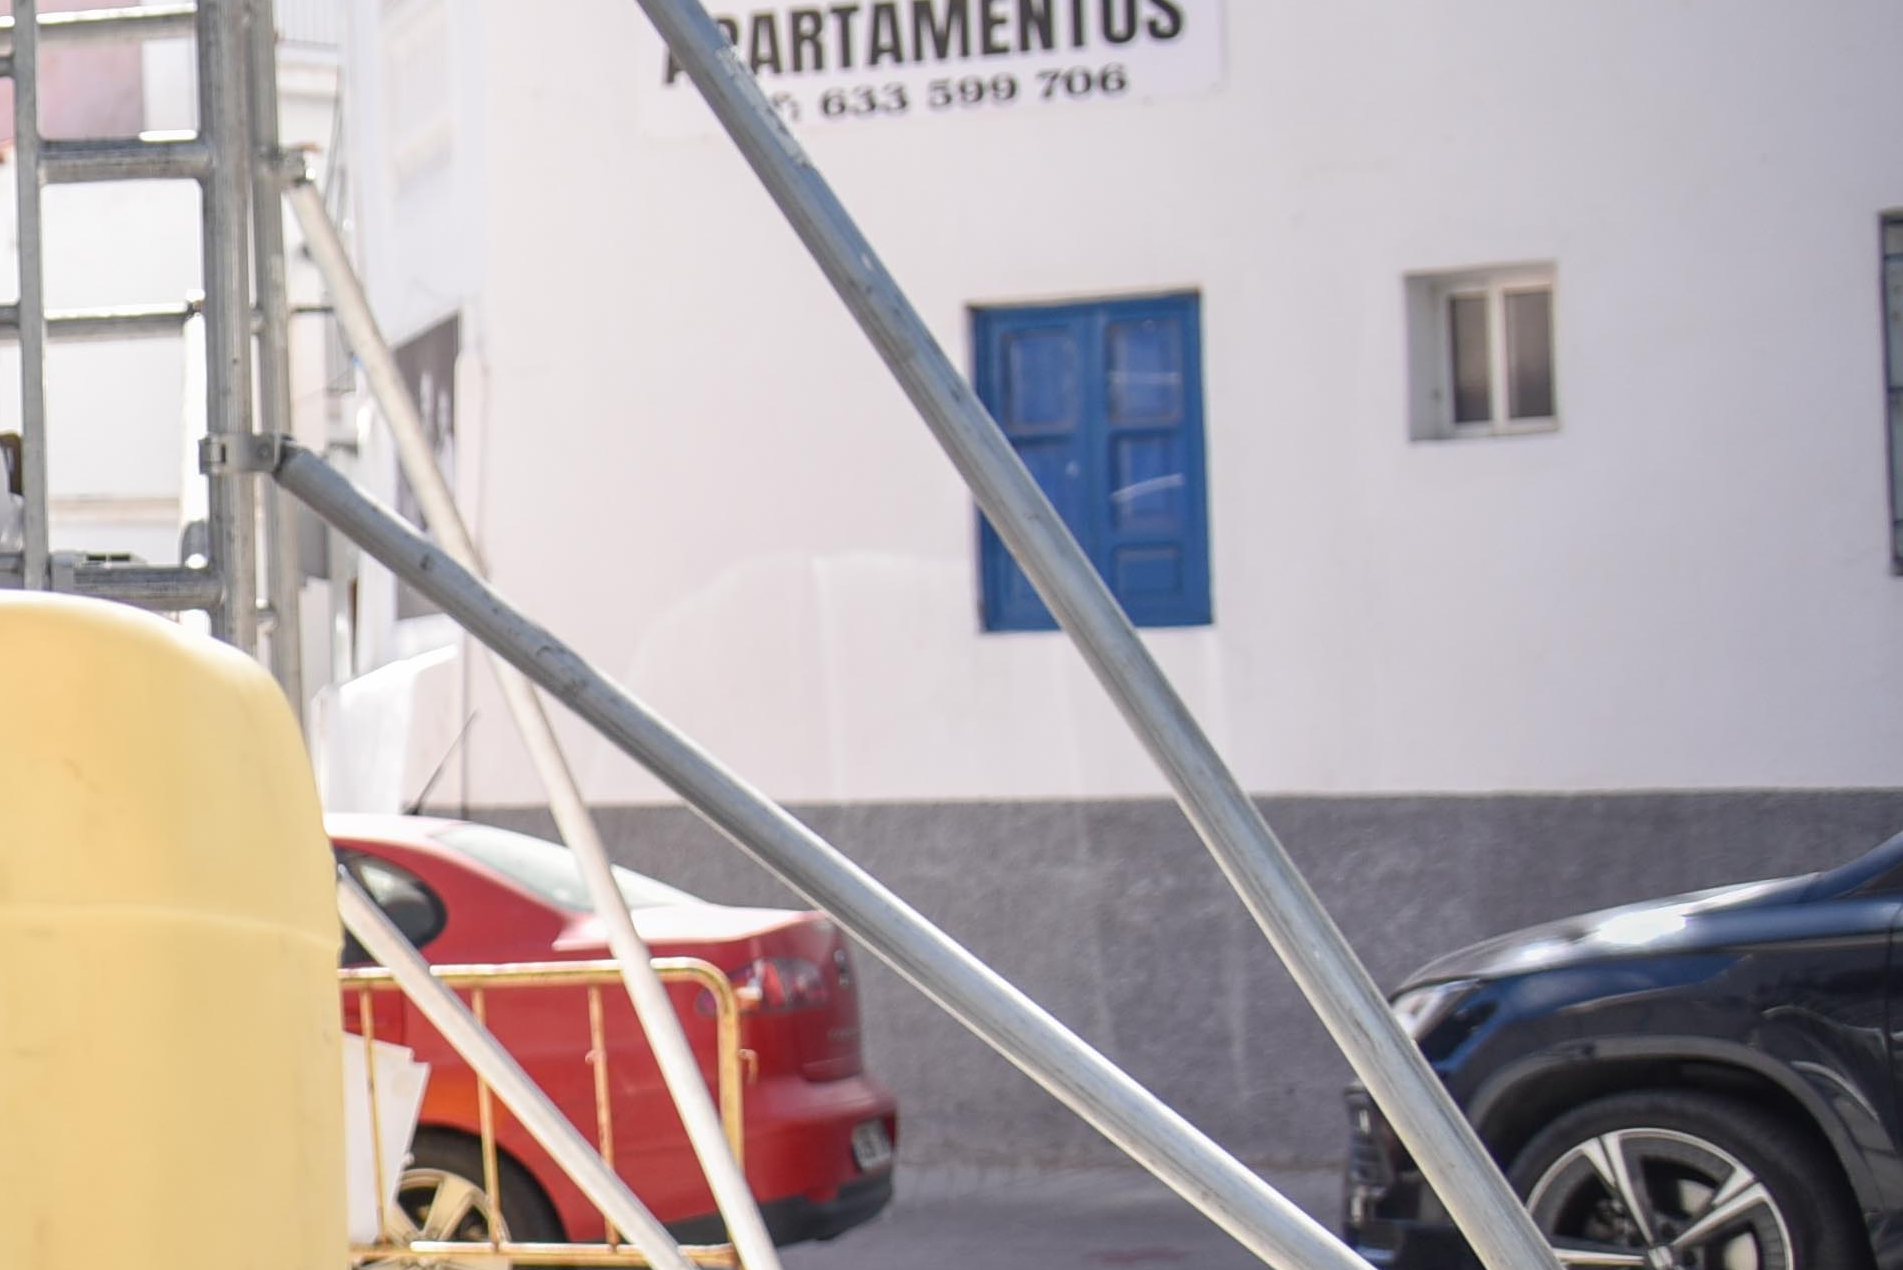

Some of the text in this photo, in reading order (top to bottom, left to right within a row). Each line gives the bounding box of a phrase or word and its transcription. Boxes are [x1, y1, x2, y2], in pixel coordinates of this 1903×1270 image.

[821, 63, 1128, 117] 633 599 706
